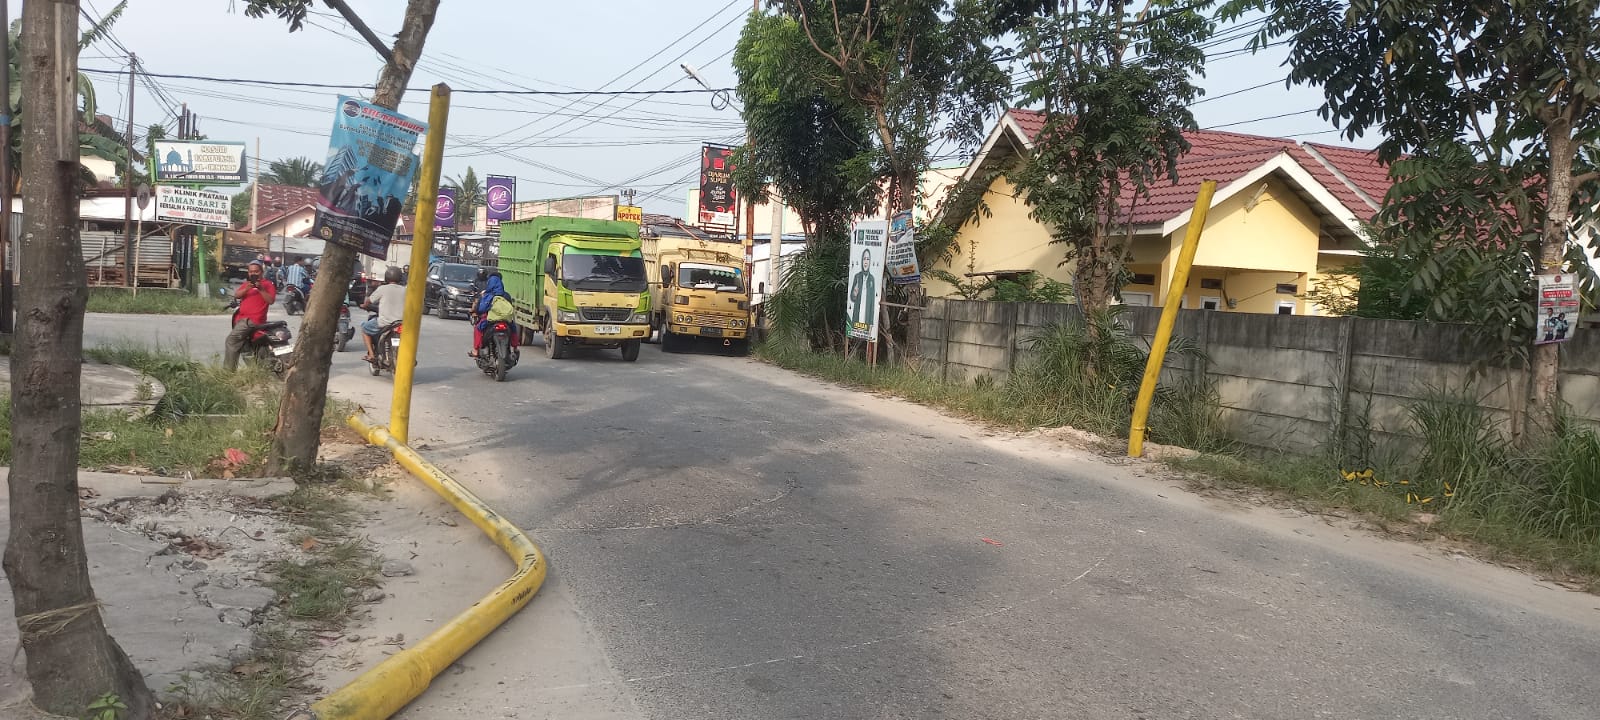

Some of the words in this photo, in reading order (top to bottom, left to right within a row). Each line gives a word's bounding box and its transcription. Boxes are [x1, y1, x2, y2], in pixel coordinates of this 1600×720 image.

[708, 171, 730, 179] DJARUM
[174, 189, 197, 198] KLINIK
[199, 192, 228, 201] PRATAMA
[492, 190, 507, 202] LA
[159, 202, 181, 211] BERSALIN
[162, 195, 195, 205] TAMAN
[197, 199, 219, 208] SARI
[436, 200, 450, 210] LA
[617, 212, 641, 221] APOTEK
